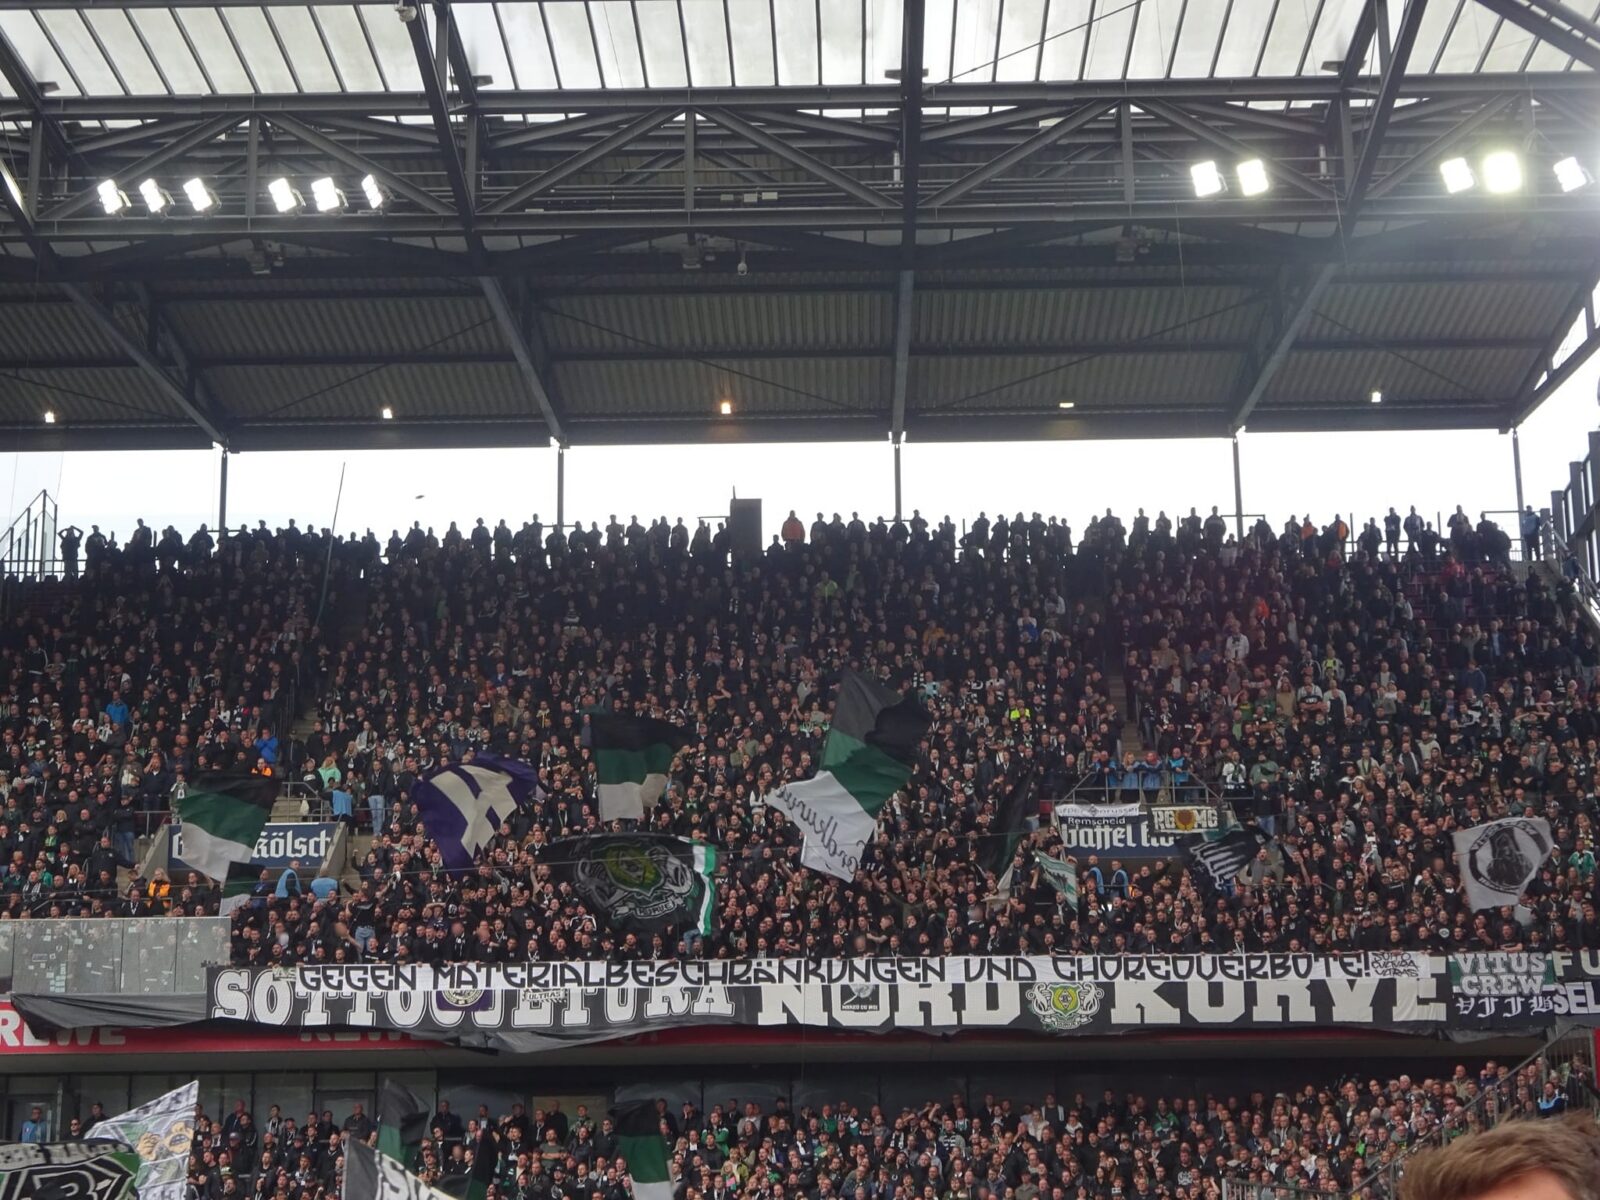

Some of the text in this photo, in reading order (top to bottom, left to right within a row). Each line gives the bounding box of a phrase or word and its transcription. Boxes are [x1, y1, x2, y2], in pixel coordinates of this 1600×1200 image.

[1067, 817, 1126, 825] Remscheid
[300, 965, 417, 990] GEGEN
[433, 958, 946, 989] MATERIALBESCHRÄNKUNGEN
[964, 957, 1037, 983] UND
[1052, 950, 1370, 981] CHOREOVERBOTE!
[1453, 953, 1546, 973] VITUS
[758, 956, 1447, 1026] NORD KURVE
[1461, 975, 1543, 995] CREW
